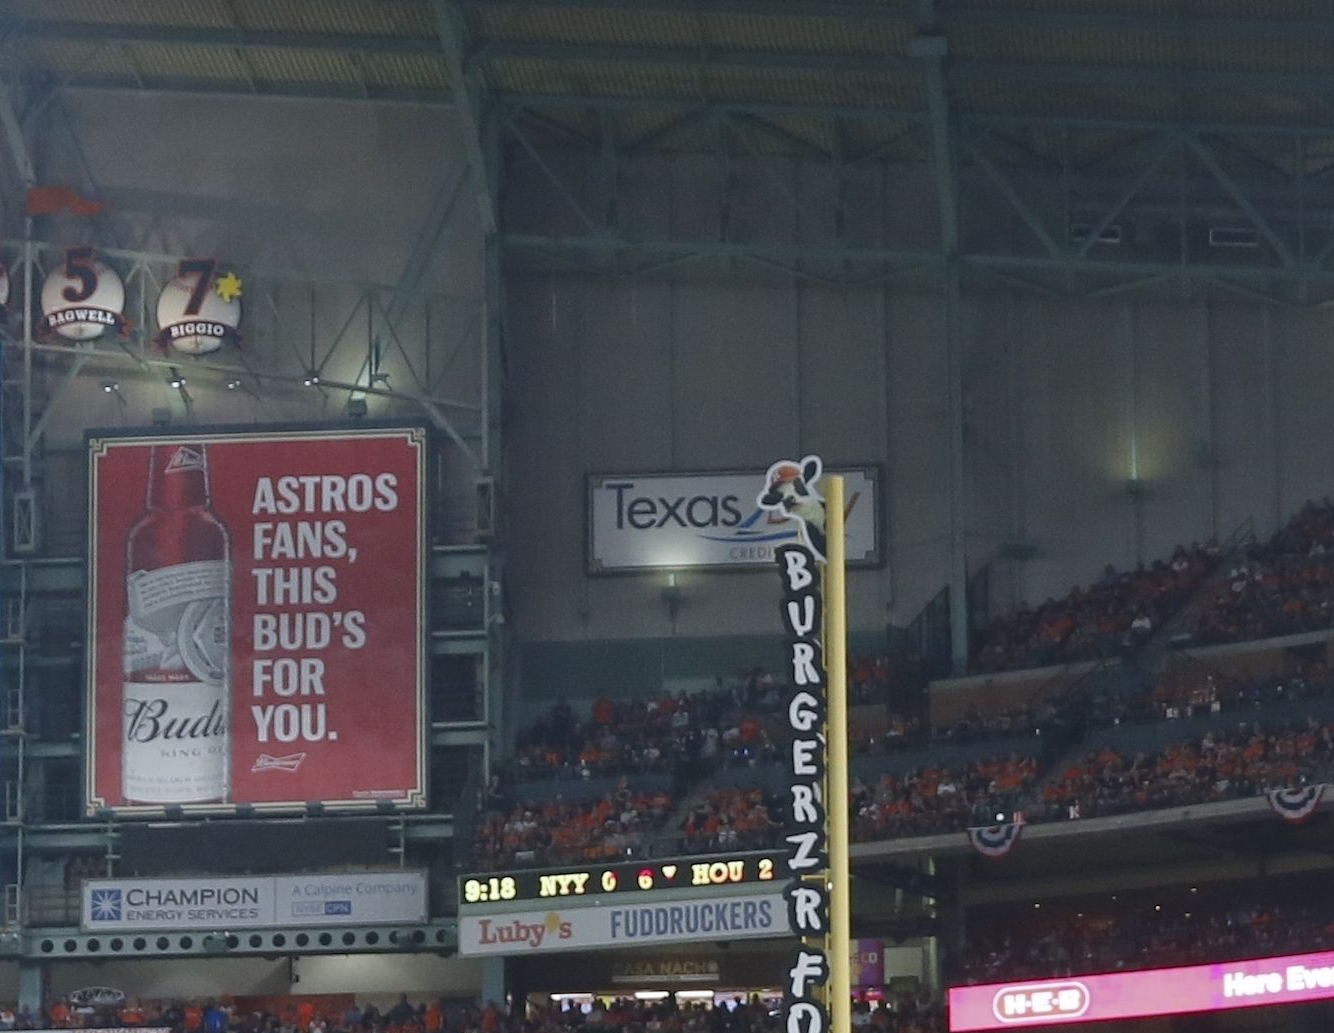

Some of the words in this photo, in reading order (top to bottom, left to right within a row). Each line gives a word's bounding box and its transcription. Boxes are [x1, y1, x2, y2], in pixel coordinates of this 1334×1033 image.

[63, 246, 98, 302] 5
[178, 257, 218, 316] 7
[47, 309, 115, 327] BAGWELL
[170, 324, 224, 338] BIGGIO
[252, 472, 399, 515] ASTROS
[605, 483, 742, 530] Texas
[252, 520, 358, 564] FANS,
[729, 546, 775, 560] CREDI
[252, 566, 337, 605] THIS
[253, 611, 366, 651] BUD'S
[253, 658, 325, 697] FOR
[251, 704, 337, 742] YOU.
[784, 549, 821, 871] BURGERZ
[126, 887, 259, 906] CHAMPION
[292, 885, 301, 897] A
[304, 883, 353, 898] Calpine
[356, 880, 419, 896] Company
[465, 877, 516, 902] 9:18
[540, 872, 589, 897] NYY
[602, 871, 617, 892] 0
[637, 868, 654, 890] 6
[692, 861, 745, 885] HOU
[758, 859, 773, 880] 2
[126, 910, 184, 921] ENERGY
[188, 908, 258, 919] SERVICES
[478, 919, 572, 948] Luby's
[610, 901, 772, 938] FUDDRUCKERS
[790, 887, 821, 931] R
[1224, 973, 1282, 998] Here
